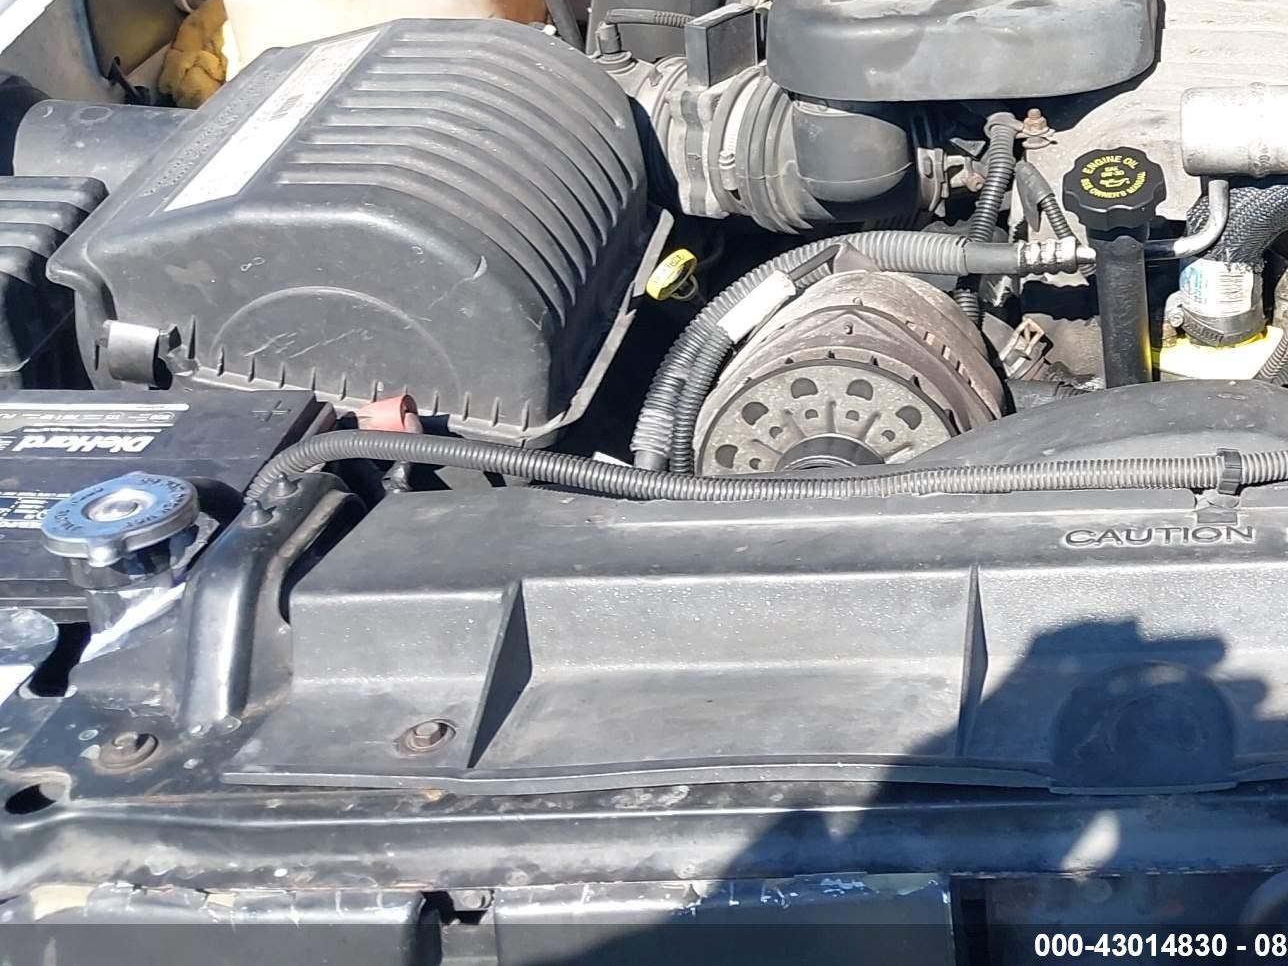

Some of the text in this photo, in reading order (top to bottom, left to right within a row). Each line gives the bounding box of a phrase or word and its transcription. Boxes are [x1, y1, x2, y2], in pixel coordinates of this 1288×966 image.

[1082, 155, 1140, 174] ENGINE OIL
[1080, 172, 1146, 199] SEE OWNER'S MANUAL
[11, 433, 155, 454] DieHard
[1064, 525, 1254, 546] CAUTION
